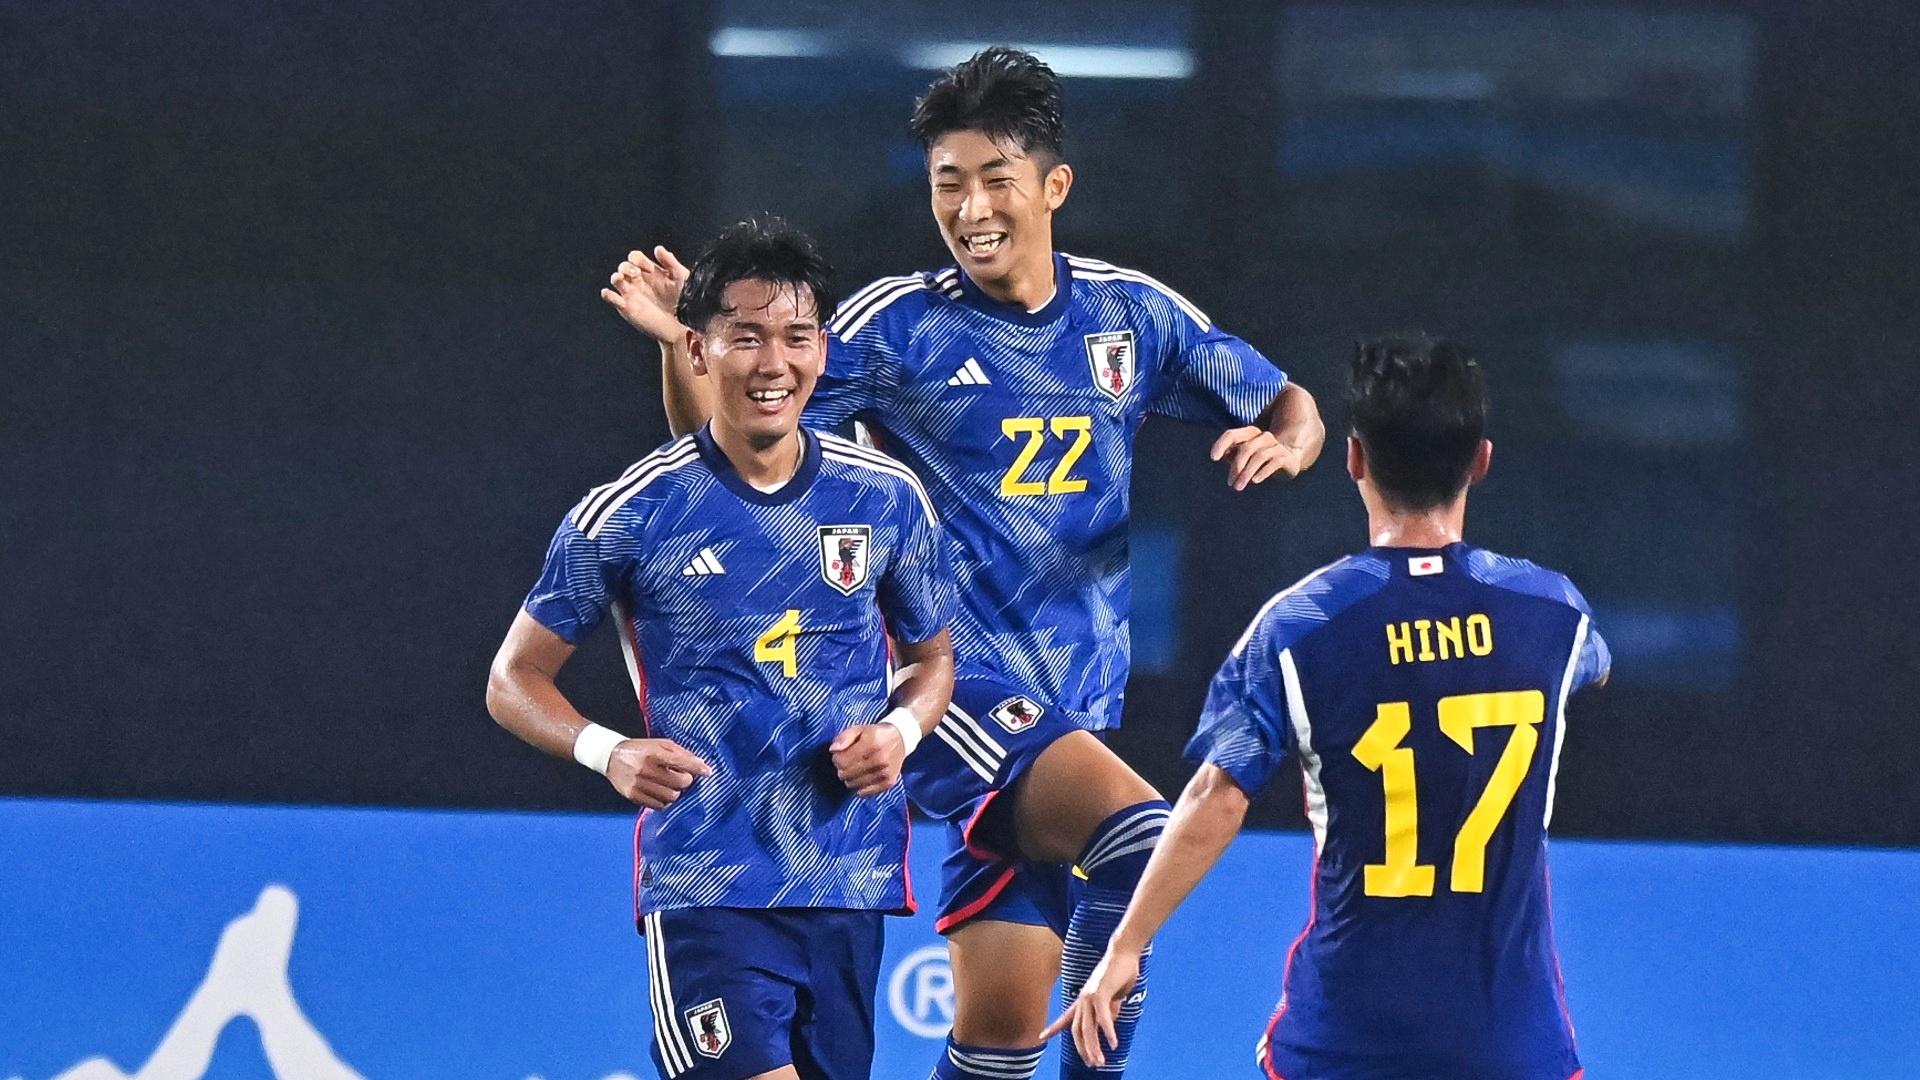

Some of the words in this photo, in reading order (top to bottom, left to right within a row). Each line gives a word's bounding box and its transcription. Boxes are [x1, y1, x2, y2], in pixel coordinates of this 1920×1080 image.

[999, 415, 1092, 497] 22
[753, 609, 801, 678] 4
[1385, 613, 1493, 665] HINO
[1350, 689, 1545, 898] 17
